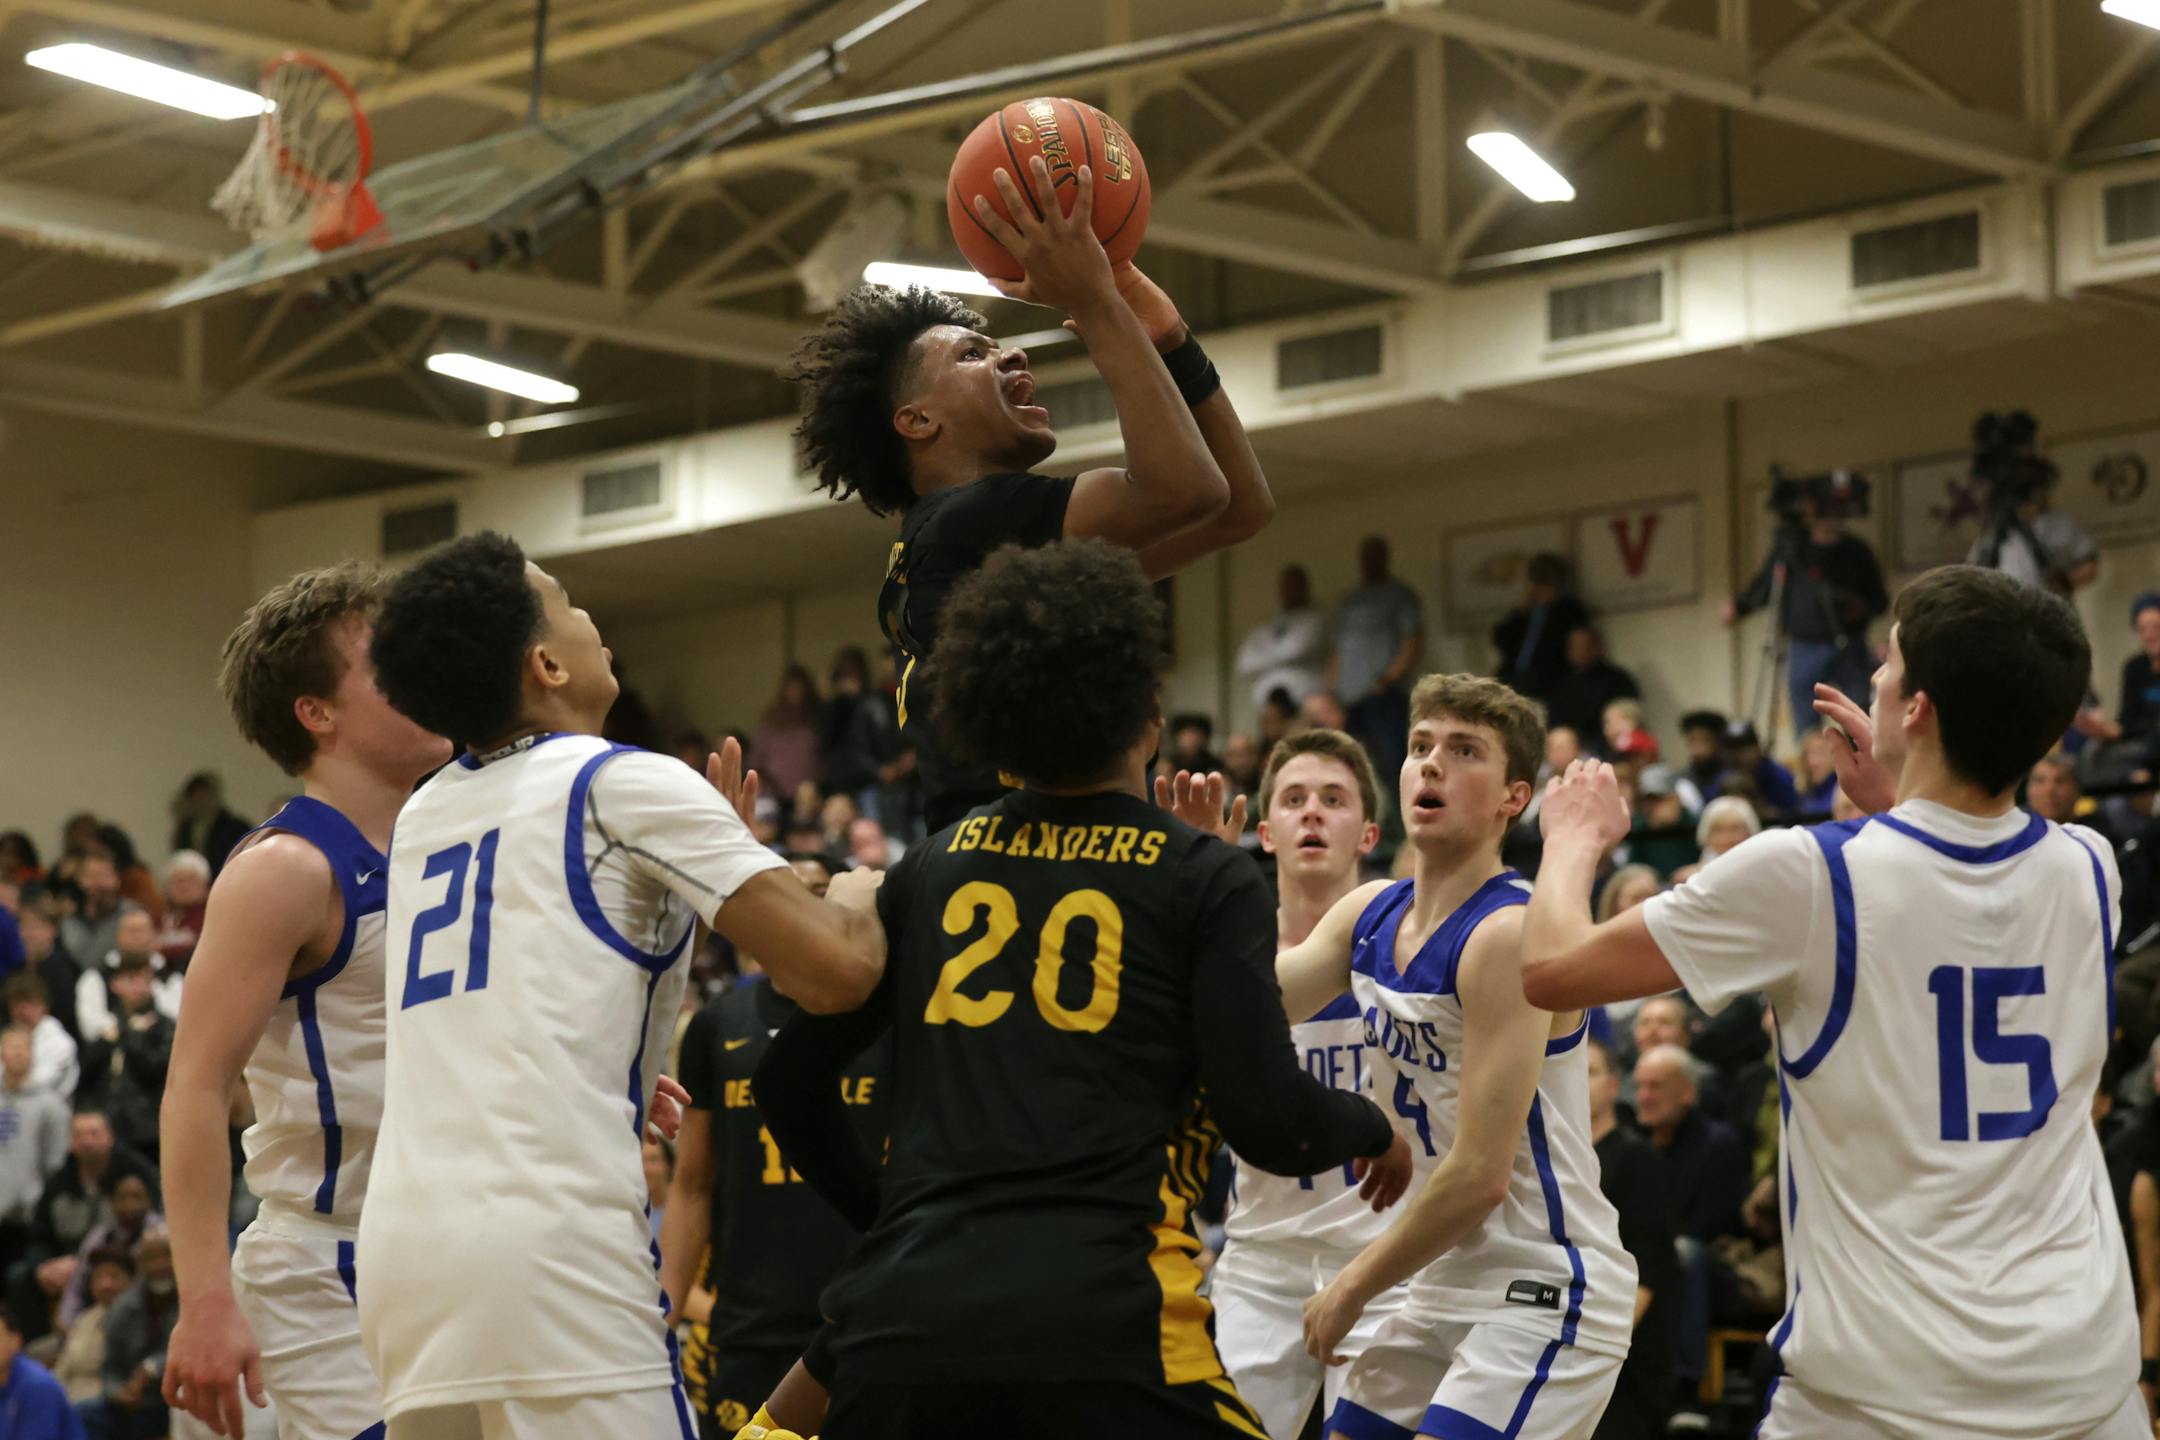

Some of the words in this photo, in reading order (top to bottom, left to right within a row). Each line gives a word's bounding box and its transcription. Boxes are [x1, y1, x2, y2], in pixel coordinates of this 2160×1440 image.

[1024, 97, 1078, 188] SPALD
[1608, 515, 1659, 577] V
[947, 816, 1166, 866] ISLANDERS
[401, 826, 500, 1011] 21
[924, 880, 1123, 1033] 20
[1928, 965, 2059, 1141] 15
[1393, 1069, 1437, 1156] 4
[1542, 1290, 1554, 1302] M
